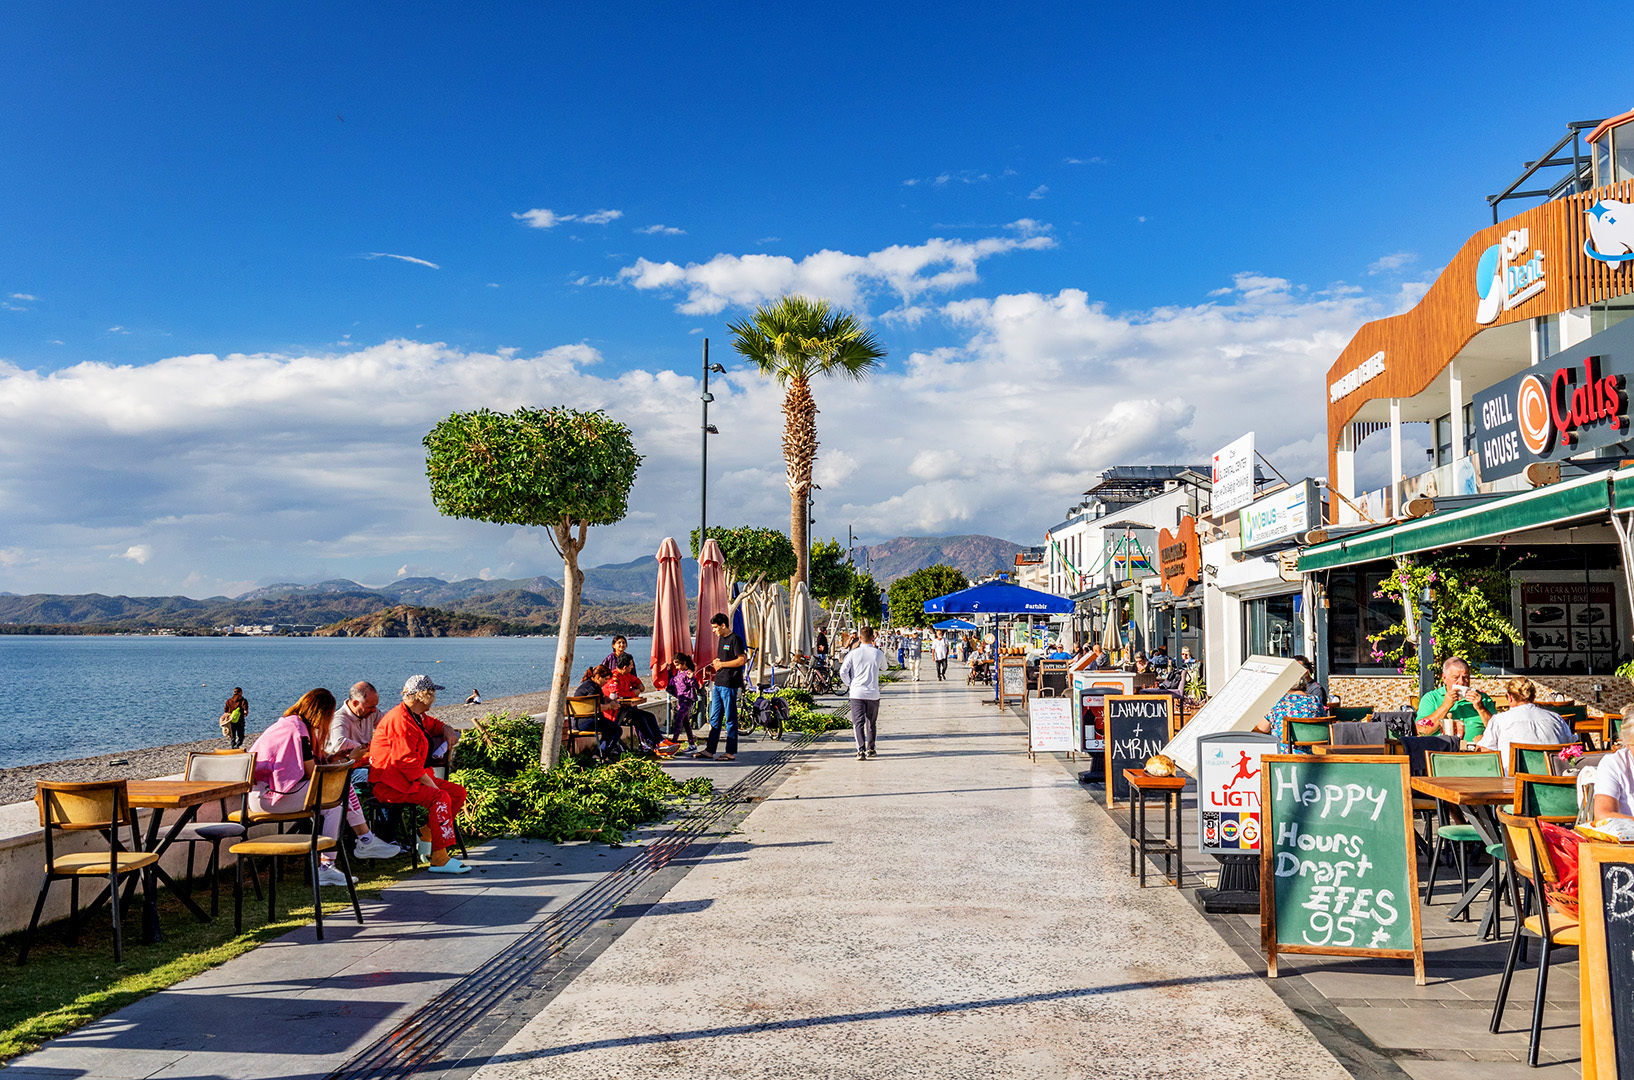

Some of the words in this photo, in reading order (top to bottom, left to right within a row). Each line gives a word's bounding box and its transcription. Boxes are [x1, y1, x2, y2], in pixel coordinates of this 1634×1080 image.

[1508, 250, 1544, 295] Dent
[1482, 394, 1512, 430] GRILL
[1551, 356, 1620, 446] Çalış
[1484, 430, 1520, 468] HOUSE
[1107, 546, 1154, 554] OLMPIA
[1110, 702, 1168, 718] LAHMACUN
[1112, 738, 1162, 760] AYRAN
[1274, 766, 1388, 822] Happy
[1276, 822, 1364, 858] Hours
[1301, 886, 1398, 926] EFES
[1302, 912, 1356, 946] 95
